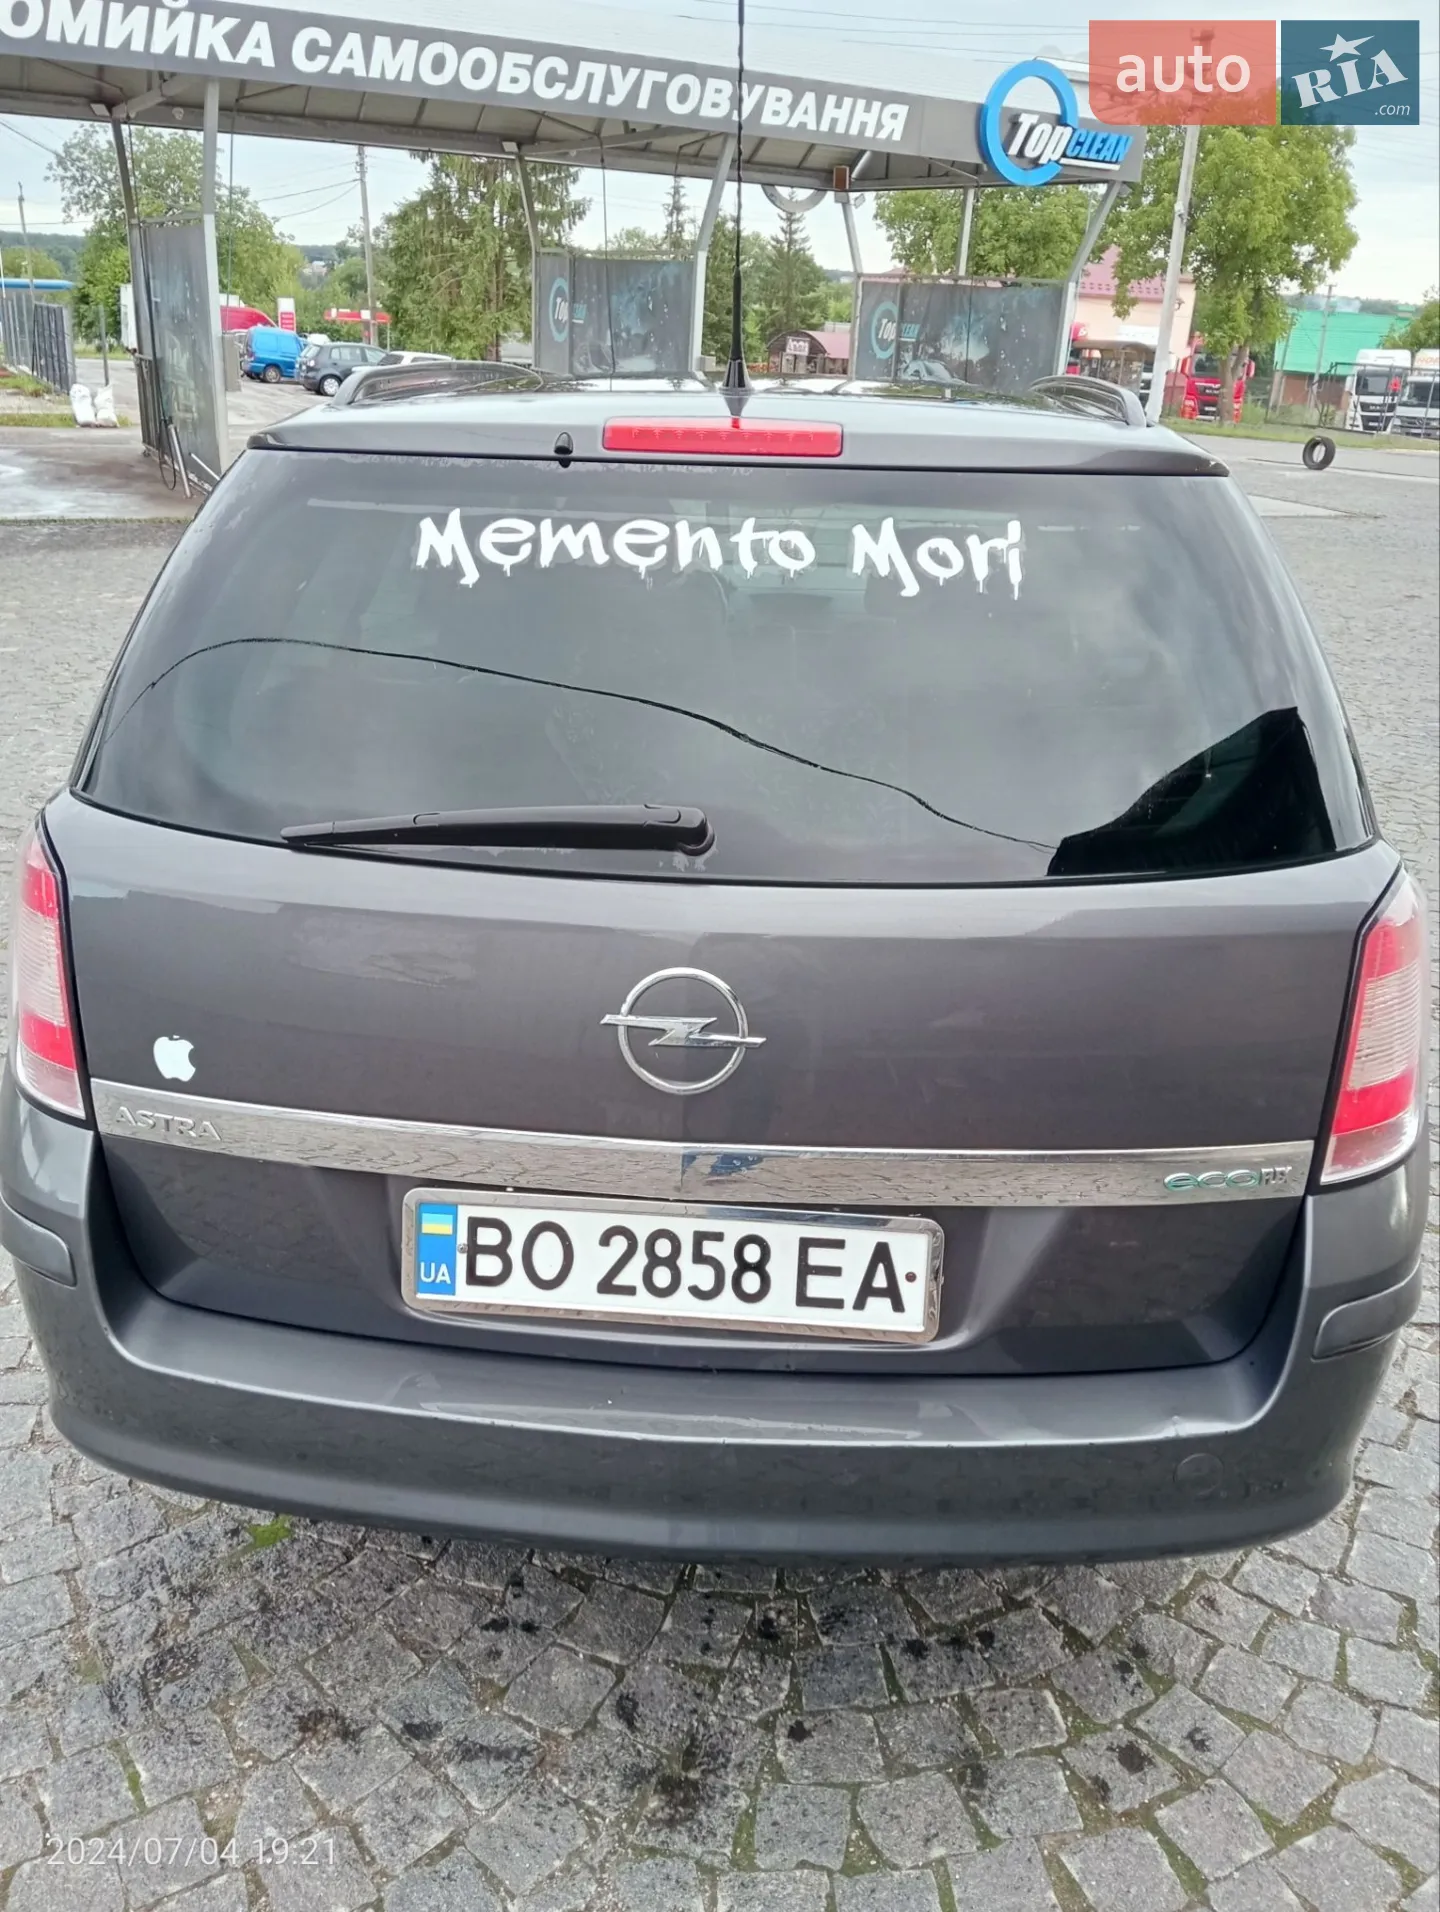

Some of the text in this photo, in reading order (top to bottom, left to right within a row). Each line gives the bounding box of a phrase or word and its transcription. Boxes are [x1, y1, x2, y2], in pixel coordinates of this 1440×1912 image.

[291, 26, 909, 142] САМООБСЛУГОВУВАННЯ
[416, 508, 1023, 600] Memento Mori
[115, 1105, 223, 1142] ASTRA
[419, 1262, 452, 1284] UA
[465, 1216, 906, 1314] BO 2858 EA
